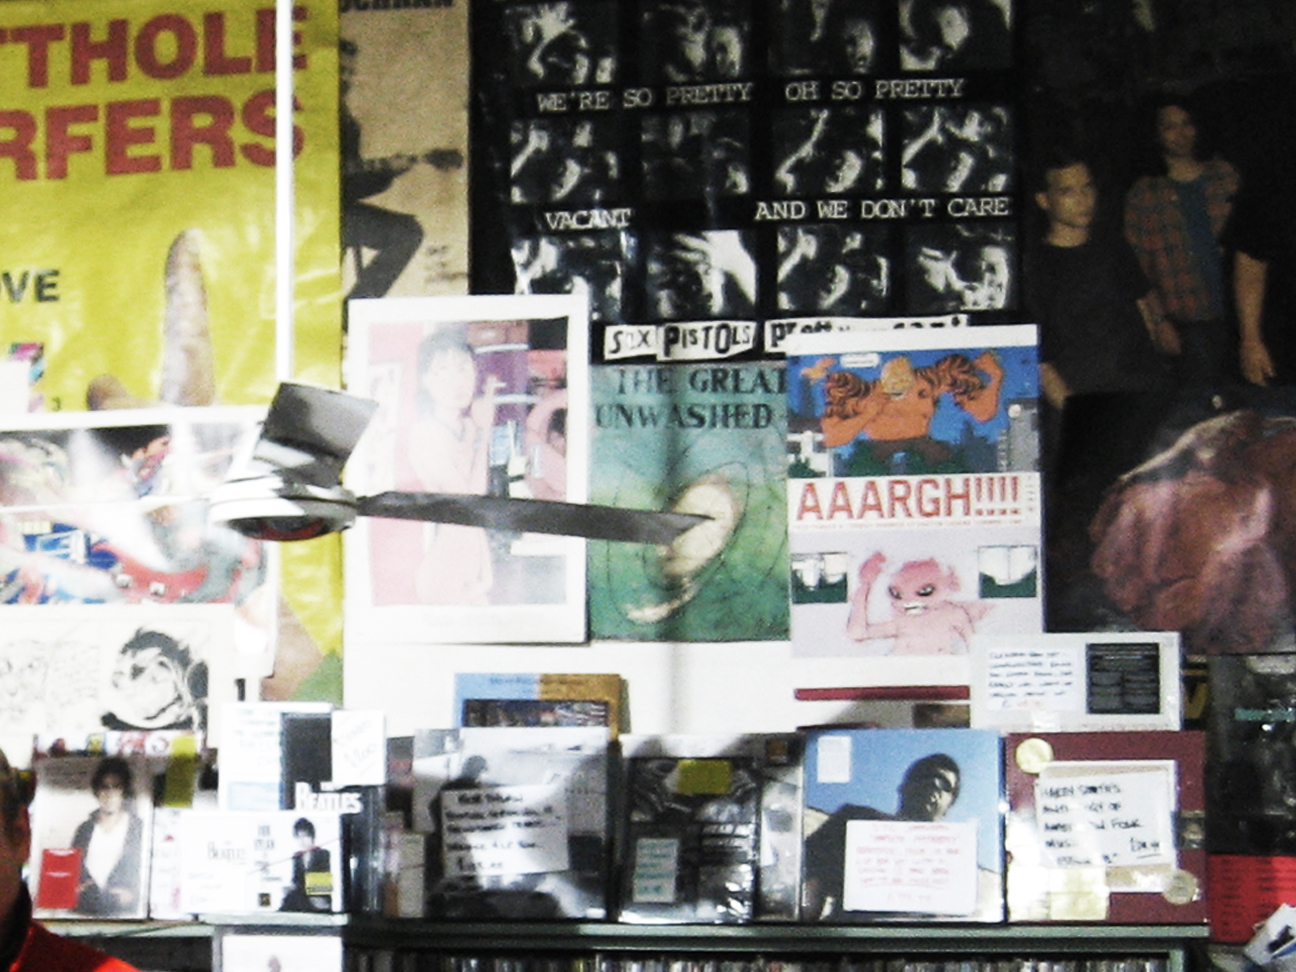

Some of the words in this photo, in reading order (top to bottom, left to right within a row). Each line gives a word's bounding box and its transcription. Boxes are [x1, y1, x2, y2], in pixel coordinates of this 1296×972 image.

[537, 90, 610, 112] WE'RE
[623, 87, 653, 109] SO
[666, 82, 753, 105] PRETTY
[785, 80, 821, 100] OH
[831, 81, 862, 100] SO
[875, 78, 964, 98] PRETTY
[545, 207, 632, 230] VACANT
[755, 200, 805, 220] AND
[816, 200, 848, 219] WE
[861, 199, 936, 218] DON'T
[947, 197, 1010, 217] CARE
[663, 322, 751, 358] PISTOLS
[617, 368, 673, 395] THE
[796, 475, 1021, 520] AAARGH!!!!
